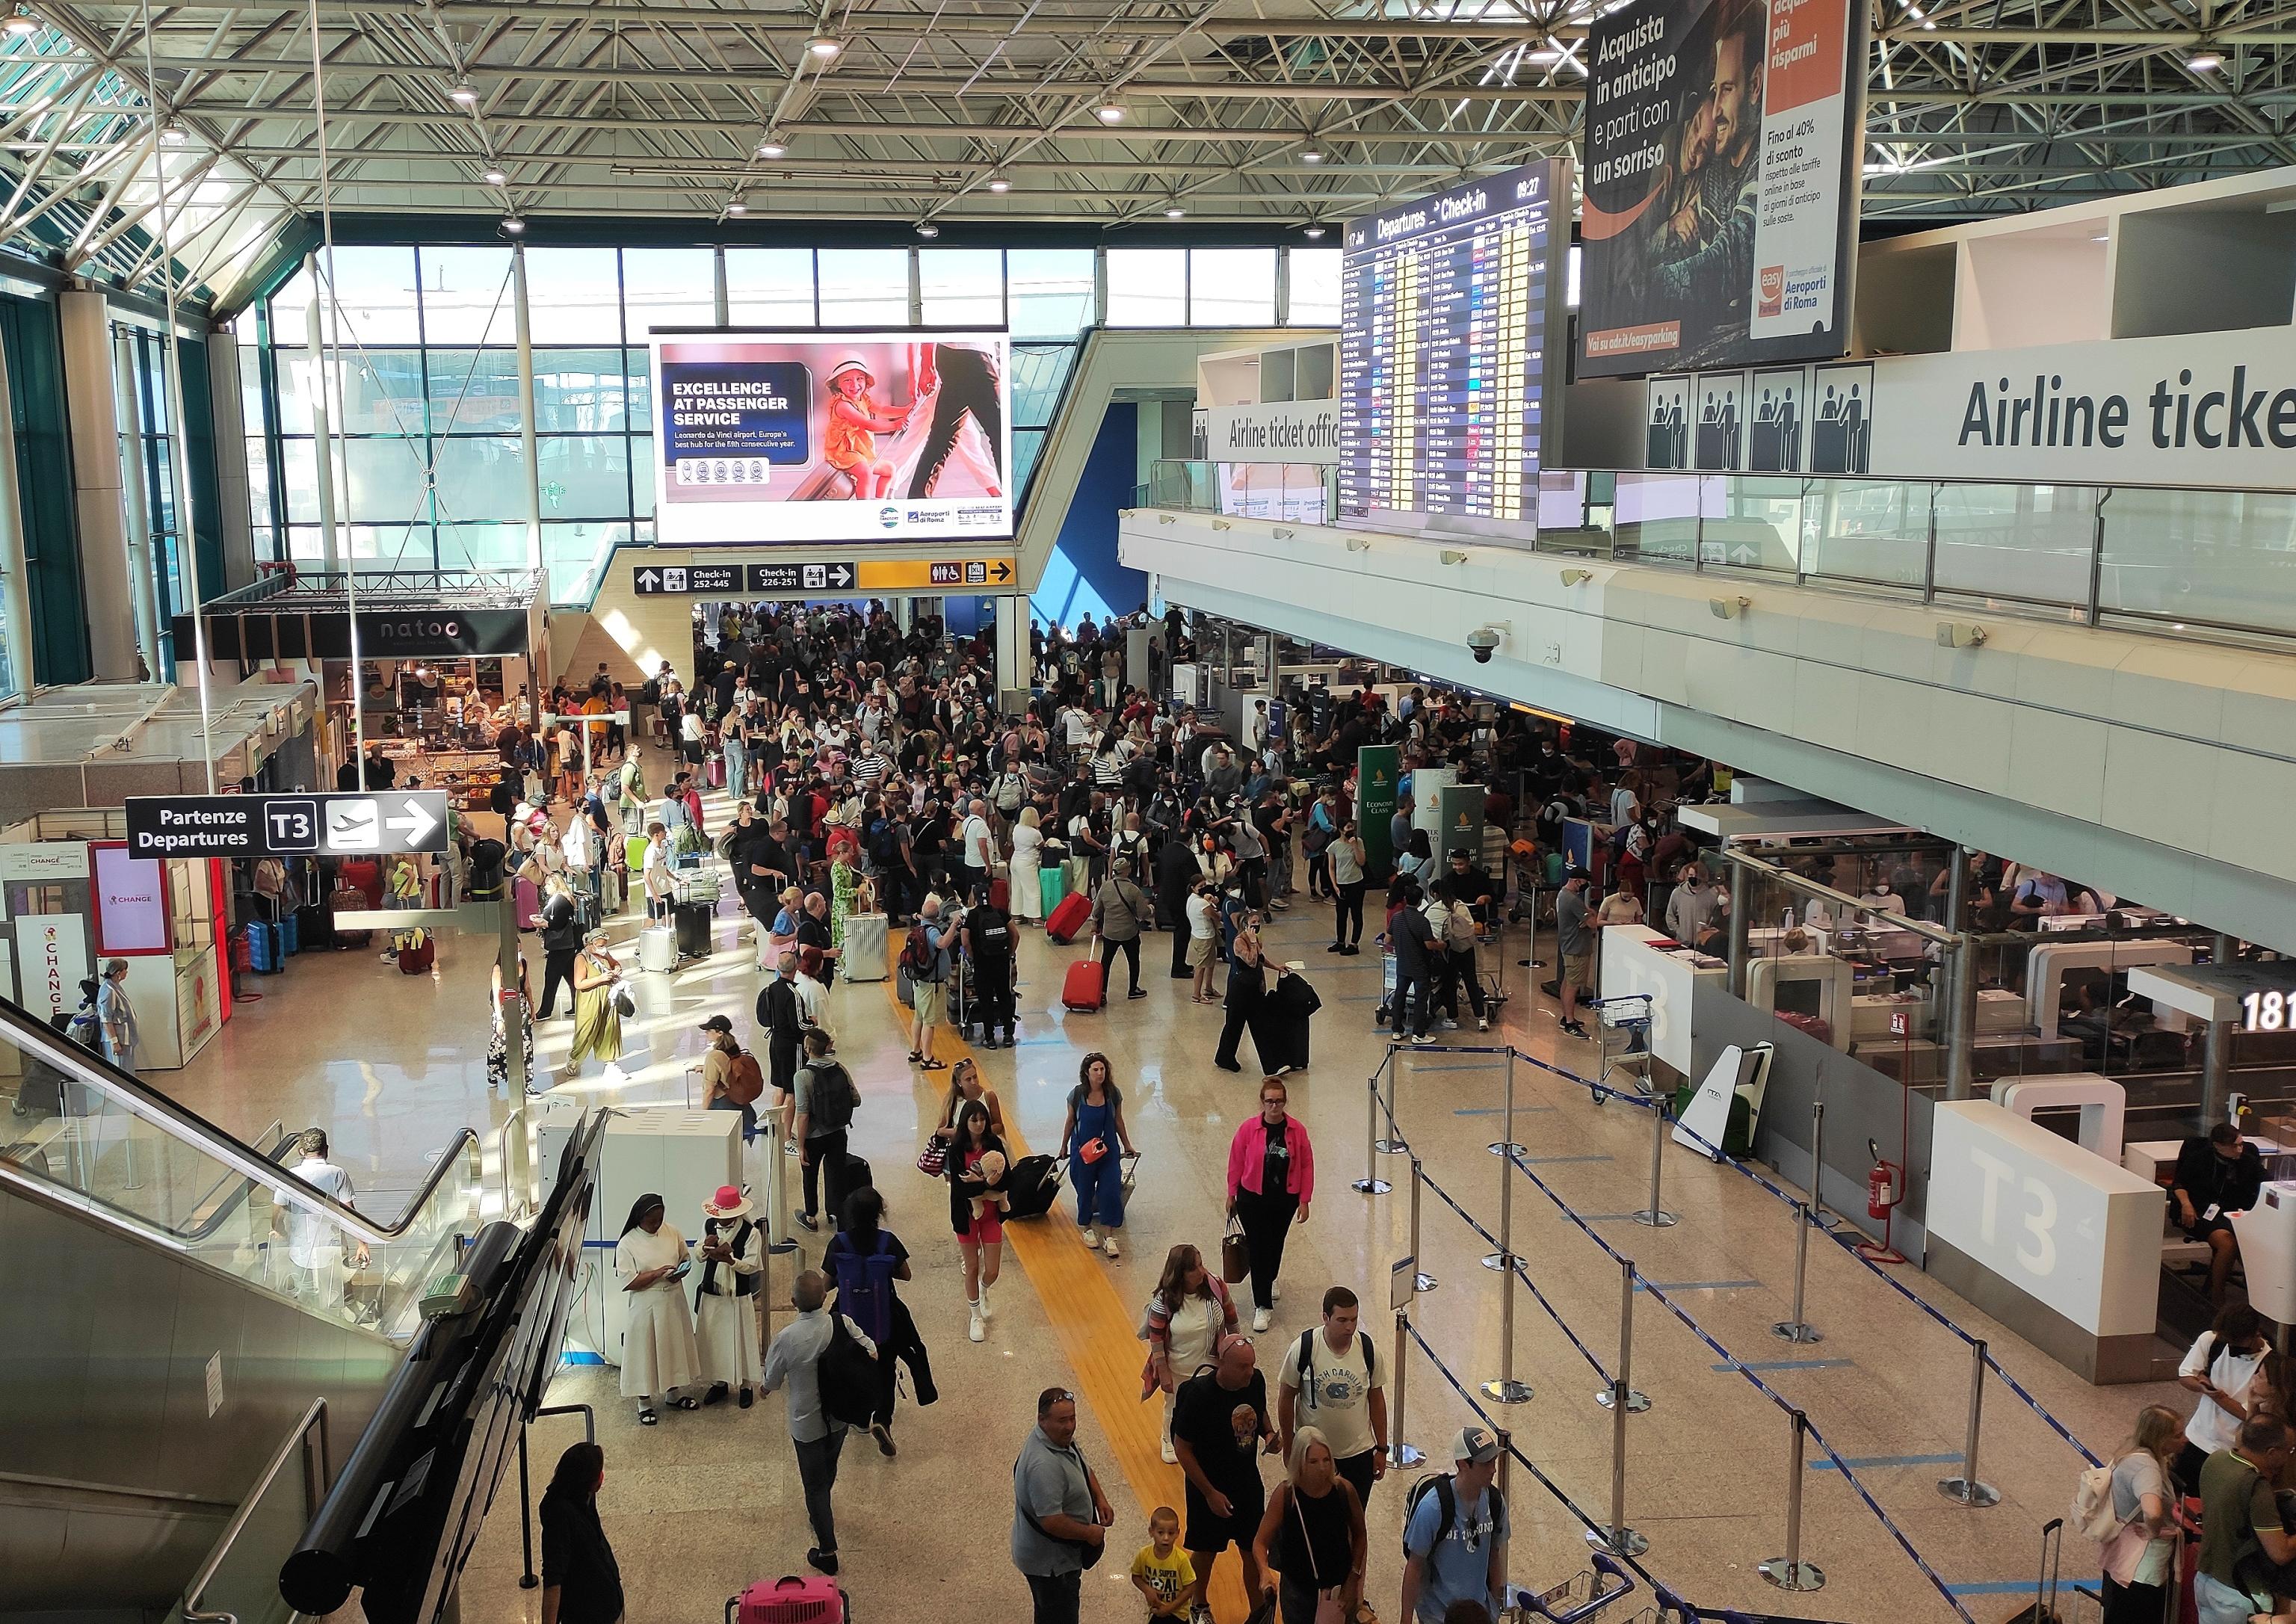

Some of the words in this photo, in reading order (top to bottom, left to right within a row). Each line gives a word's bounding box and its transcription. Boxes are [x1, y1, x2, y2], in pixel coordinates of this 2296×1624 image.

[1597, 14, 1664, 66] Acquista
[1772, 19, 1790, 48] più
[1771, 33, 1818, 70] risparmi
[1596, 75, 1610, 105] in
[1613, 53, 1676, 91] anticipo
[1595, 123, 1603, 145] e
[1606, 102, 1640, 149] parti
[1643, 99, 1670, 129] con
[1767, 130, 1785, 146] Fino
[1786, 124, 1794, 141] al
[1795, 118, 1815, 137] 40%
[1593, 159, 1611, 185] un
[1613, 139, 1664, 179] sorriso
[1766, 149, 1774, 165] di
[1776, 145, 1803, 164] sconto
[1765, 167, 1789, 182] rispetto
[1789, 162, 1800, 175] alle
[1802, 157, 1821, 172] tariffe
[1516, 176, 1540, 199] 09:27
[1764, 182, 1783, 197] online
[1783, 181, 1789, 192] in
[1790, 179, 1805, 191] base
[1763, 200, 1770, 212] ai
[1771, 197, 1787, 213] giorni
[1789, 195, 1794, 206] di
[1795, 190, 1821, 204] anticipo
[1377, 210, 1426, 241] Departures
[1441, 187, 1487, 221] Check-in
[1762, 271, 1783, 289] easy
[1785, 275, 1827, 295] Aeroporti
[1784, 297, 1792, 311] di
[1793, 296, 1817, 309] Roma
[1588, 336, 1599, 351] Vai
[1599, 339, 1608, 350] su
[1609, 327, 1678, 350] adr.it/easyparking
[673, 382, 771, 395] EXCELLENCE
[673, 398, 694, 410] AT
[697, 397, 789, 410] PASSENGER
[1957, 374, 2129, 449] Airline
[2149, 365, 2296, 449] ticke
[673, 413, 741, 425] SERVICE
[733, 431, 757, 440] airport,
[759, 430, 787, 439] Europe's
[1229, 416, 1266, 448] Airline
[1269, 415, 1303, 448] ticket
[1308, 413, 1339, 448] offic
[741, 439, 779, 448] consecutive
[780, 440, 796, 448] year.
[694, 569, 731, 578] Check-in
[759, 568, 797, 577] Check-in
[762, 578, 797, 587] 226-251
[694, 579, 729, 588] 252-445
[380, 620, 459, 637] natoo
[1366, 800, 1394, 809] ECONOMY
[160, 809, 247, 826] Partenze
[270, 812, 310, 839] T3
[138, 831, 248, 851] Departures
[46, 942, 61, 1016] CHANGE
[2244, 991, 2296, 1031] 181
[1971, 1145, 2058, 1276] T3
